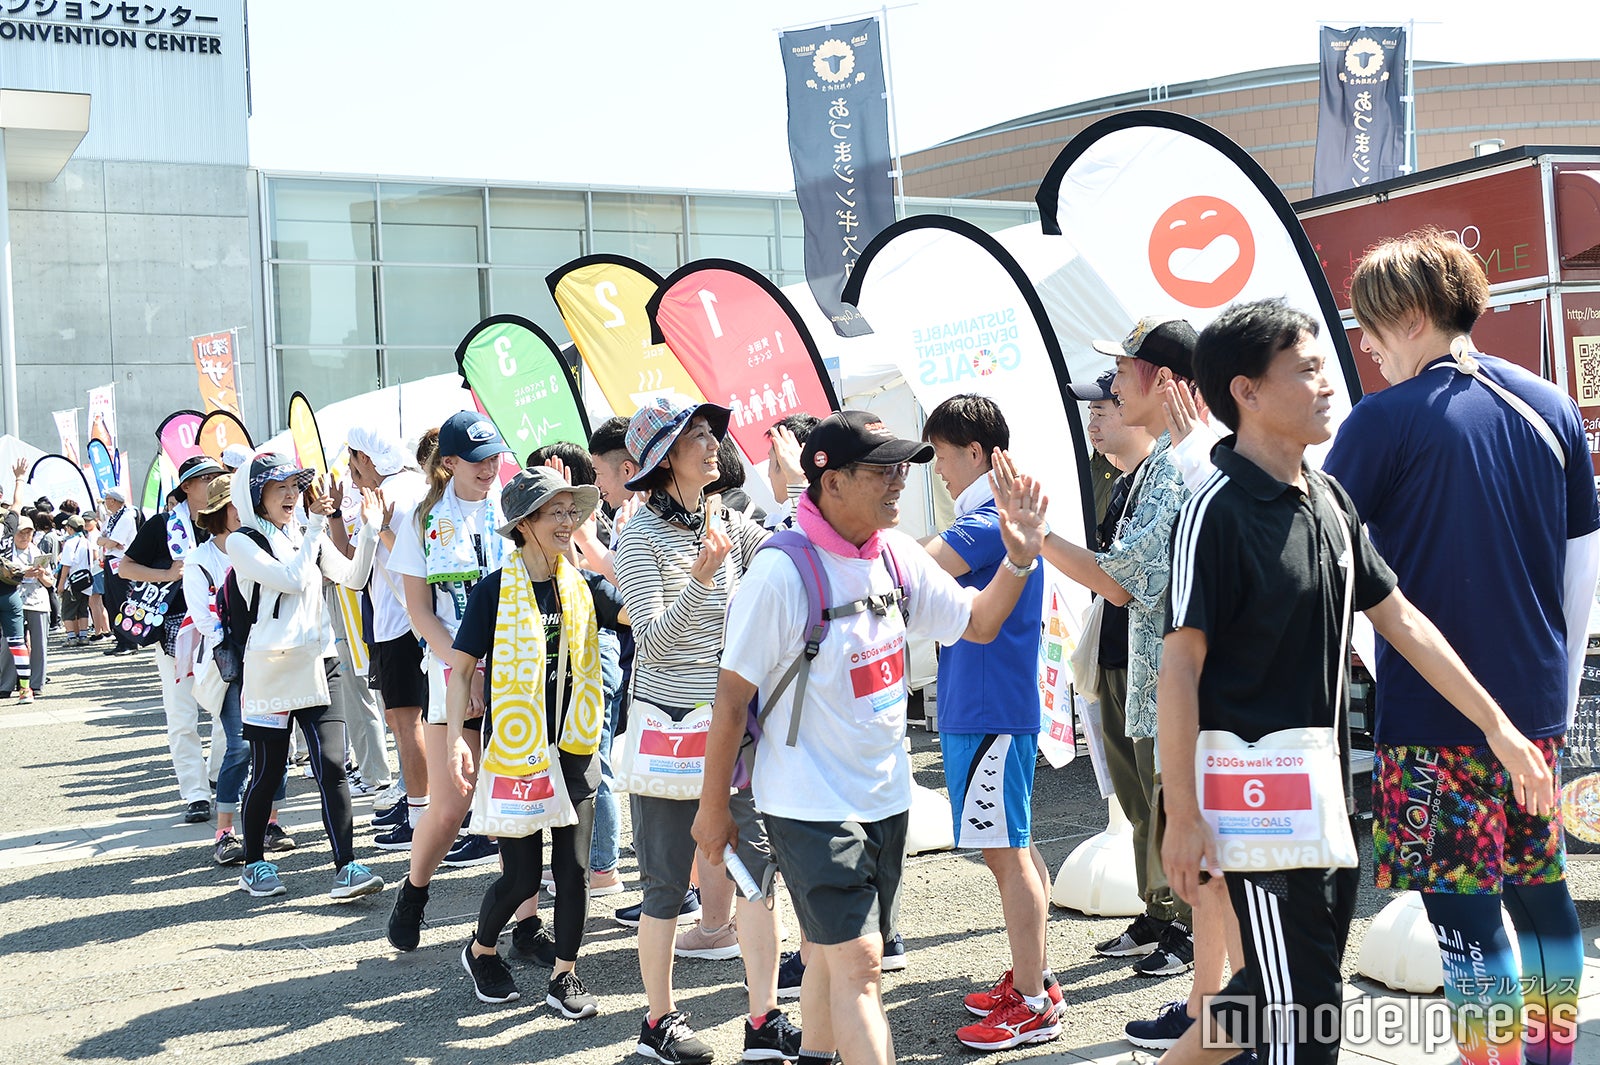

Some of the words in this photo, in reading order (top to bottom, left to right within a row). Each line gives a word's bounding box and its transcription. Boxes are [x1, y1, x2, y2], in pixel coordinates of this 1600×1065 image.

[0, 0, 218, 27] ンションセンター
[0, 22, 137, 48] ONVENTION
[145, 33, 222, 55] CENTER
[1472, 243, 1531, 275] YLE
[1582, 418, 1600, 430] Caf
[880, 661, 893, 685] 3
[246, 697, 292, 713] SDGs
[668, 735, 684, 756] 7
[1216, 757, 1244, 768] SDGs
[1247, 756, 1272, 768] walk
[1275, 757, 1304, 767] 2019
[512, 782, 533, 800] 47
[612, 771, 681, 797] SDGs
[1243, 778, 1266, 808] 6
[1400, 748, 1440, 866] SVOLME
[471, 815, 529, 835] SDGs
[1251, 817, 1292, 828] GOALS
